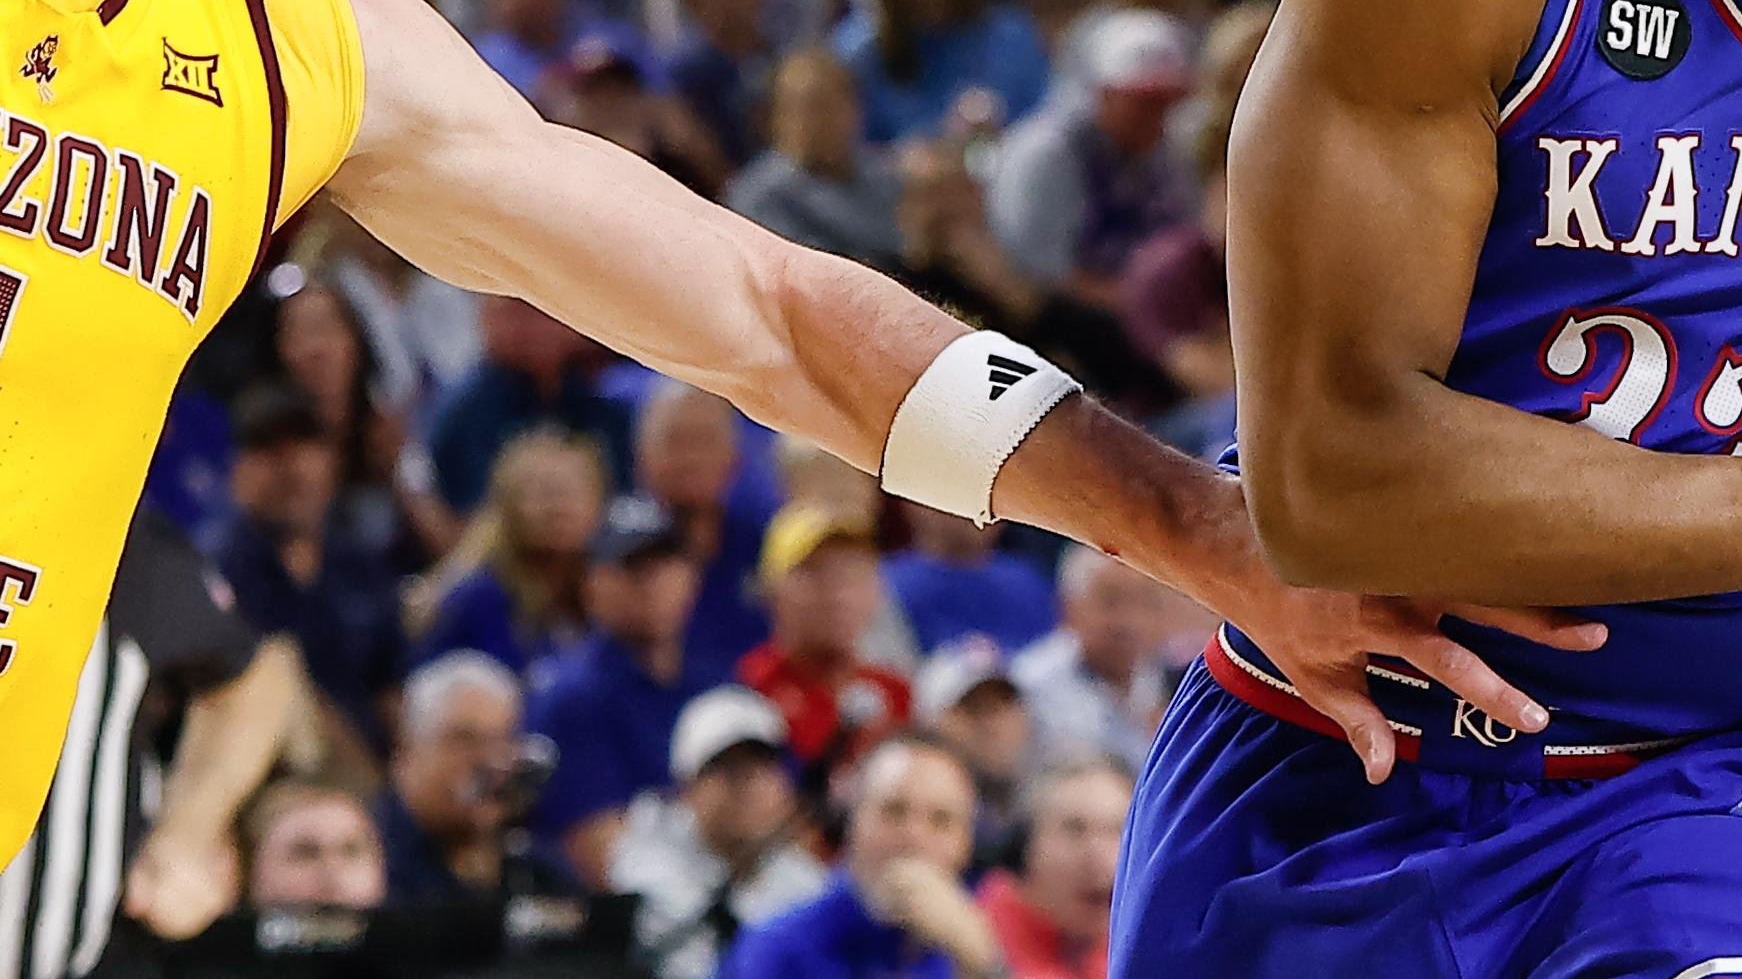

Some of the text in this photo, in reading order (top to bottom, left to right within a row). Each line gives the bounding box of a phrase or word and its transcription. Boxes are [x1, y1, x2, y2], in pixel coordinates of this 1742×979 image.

[1607, 0, 1679, 59] SW
[162, 39, 222, 106] XII
[1451, 698, 1517, 747] KU
